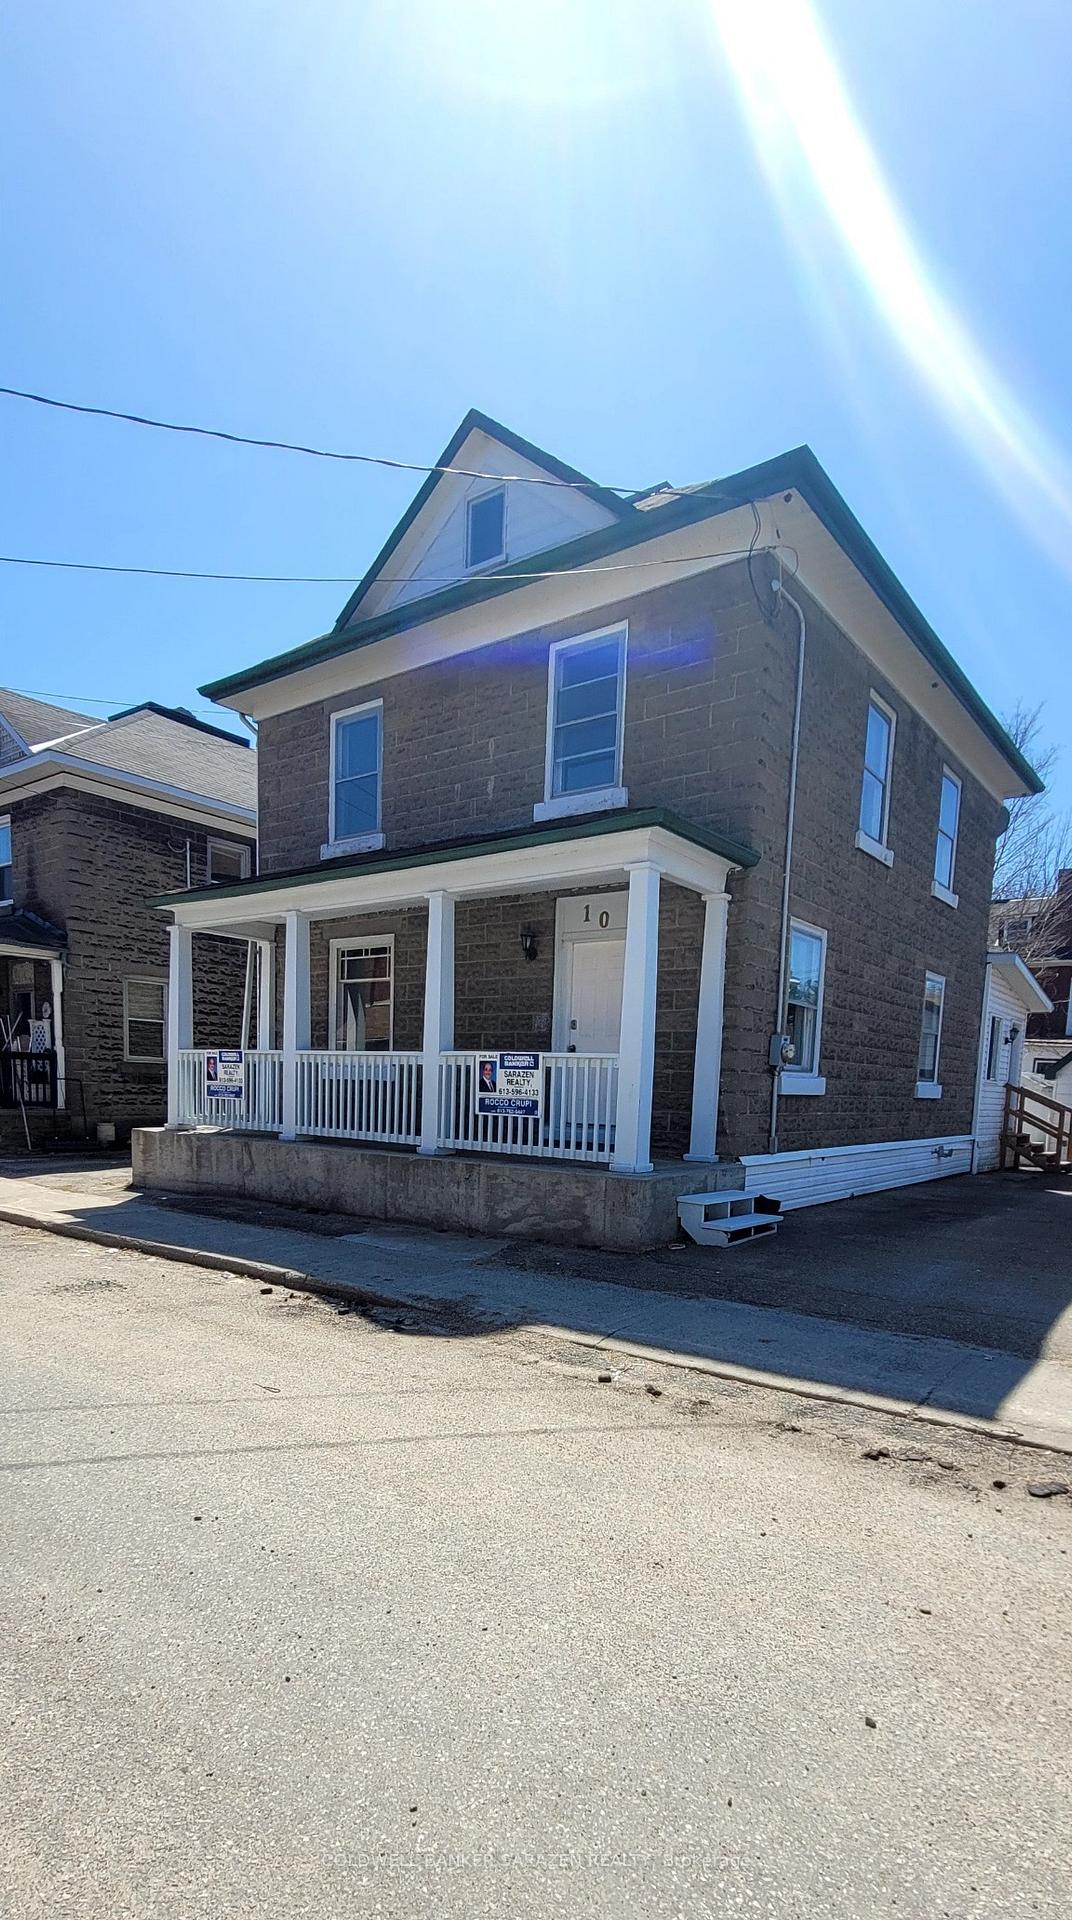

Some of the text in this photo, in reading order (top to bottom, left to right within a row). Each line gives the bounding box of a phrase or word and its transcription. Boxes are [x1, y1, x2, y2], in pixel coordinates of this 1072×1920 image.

[583, 904, 610, 928] 10
[503, 1070, 535, 1078] SARAZEN
[498, 1087, 539, 1096] 613-596-4133
[484, 1098, 532, 1107] ROCCO CRUPI
